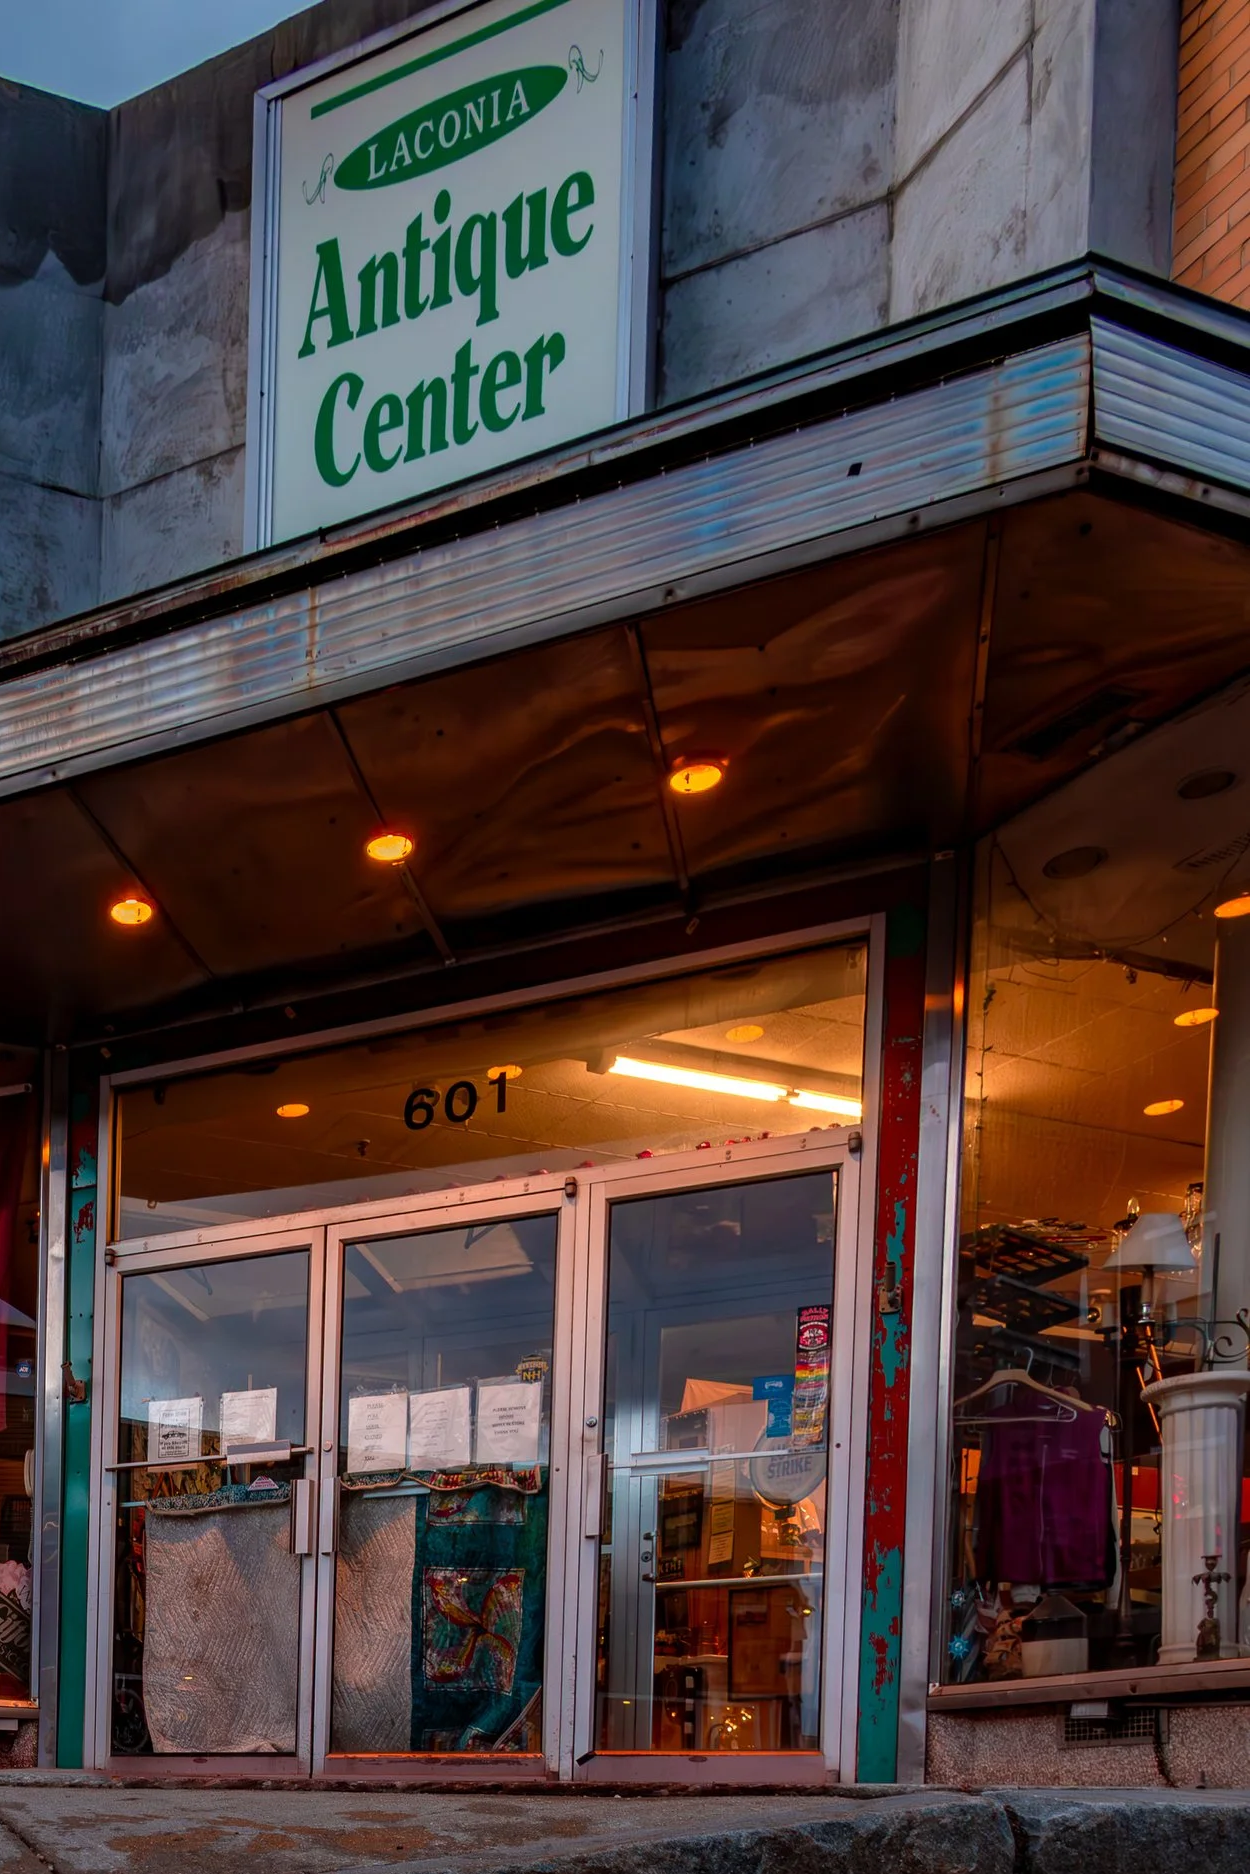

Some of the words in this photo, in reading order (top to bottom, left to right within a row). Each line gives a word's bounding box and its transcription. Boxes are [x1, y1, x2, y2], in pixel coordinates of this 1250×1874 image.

[366, 78, 532, 183] LACONIA
[297, 170, 596, 360] Antique
[314, 331, 566, 488] Center
[403, 1070, 508, 1131] 601
[766, 1455, 814, 1480] STRIKE
